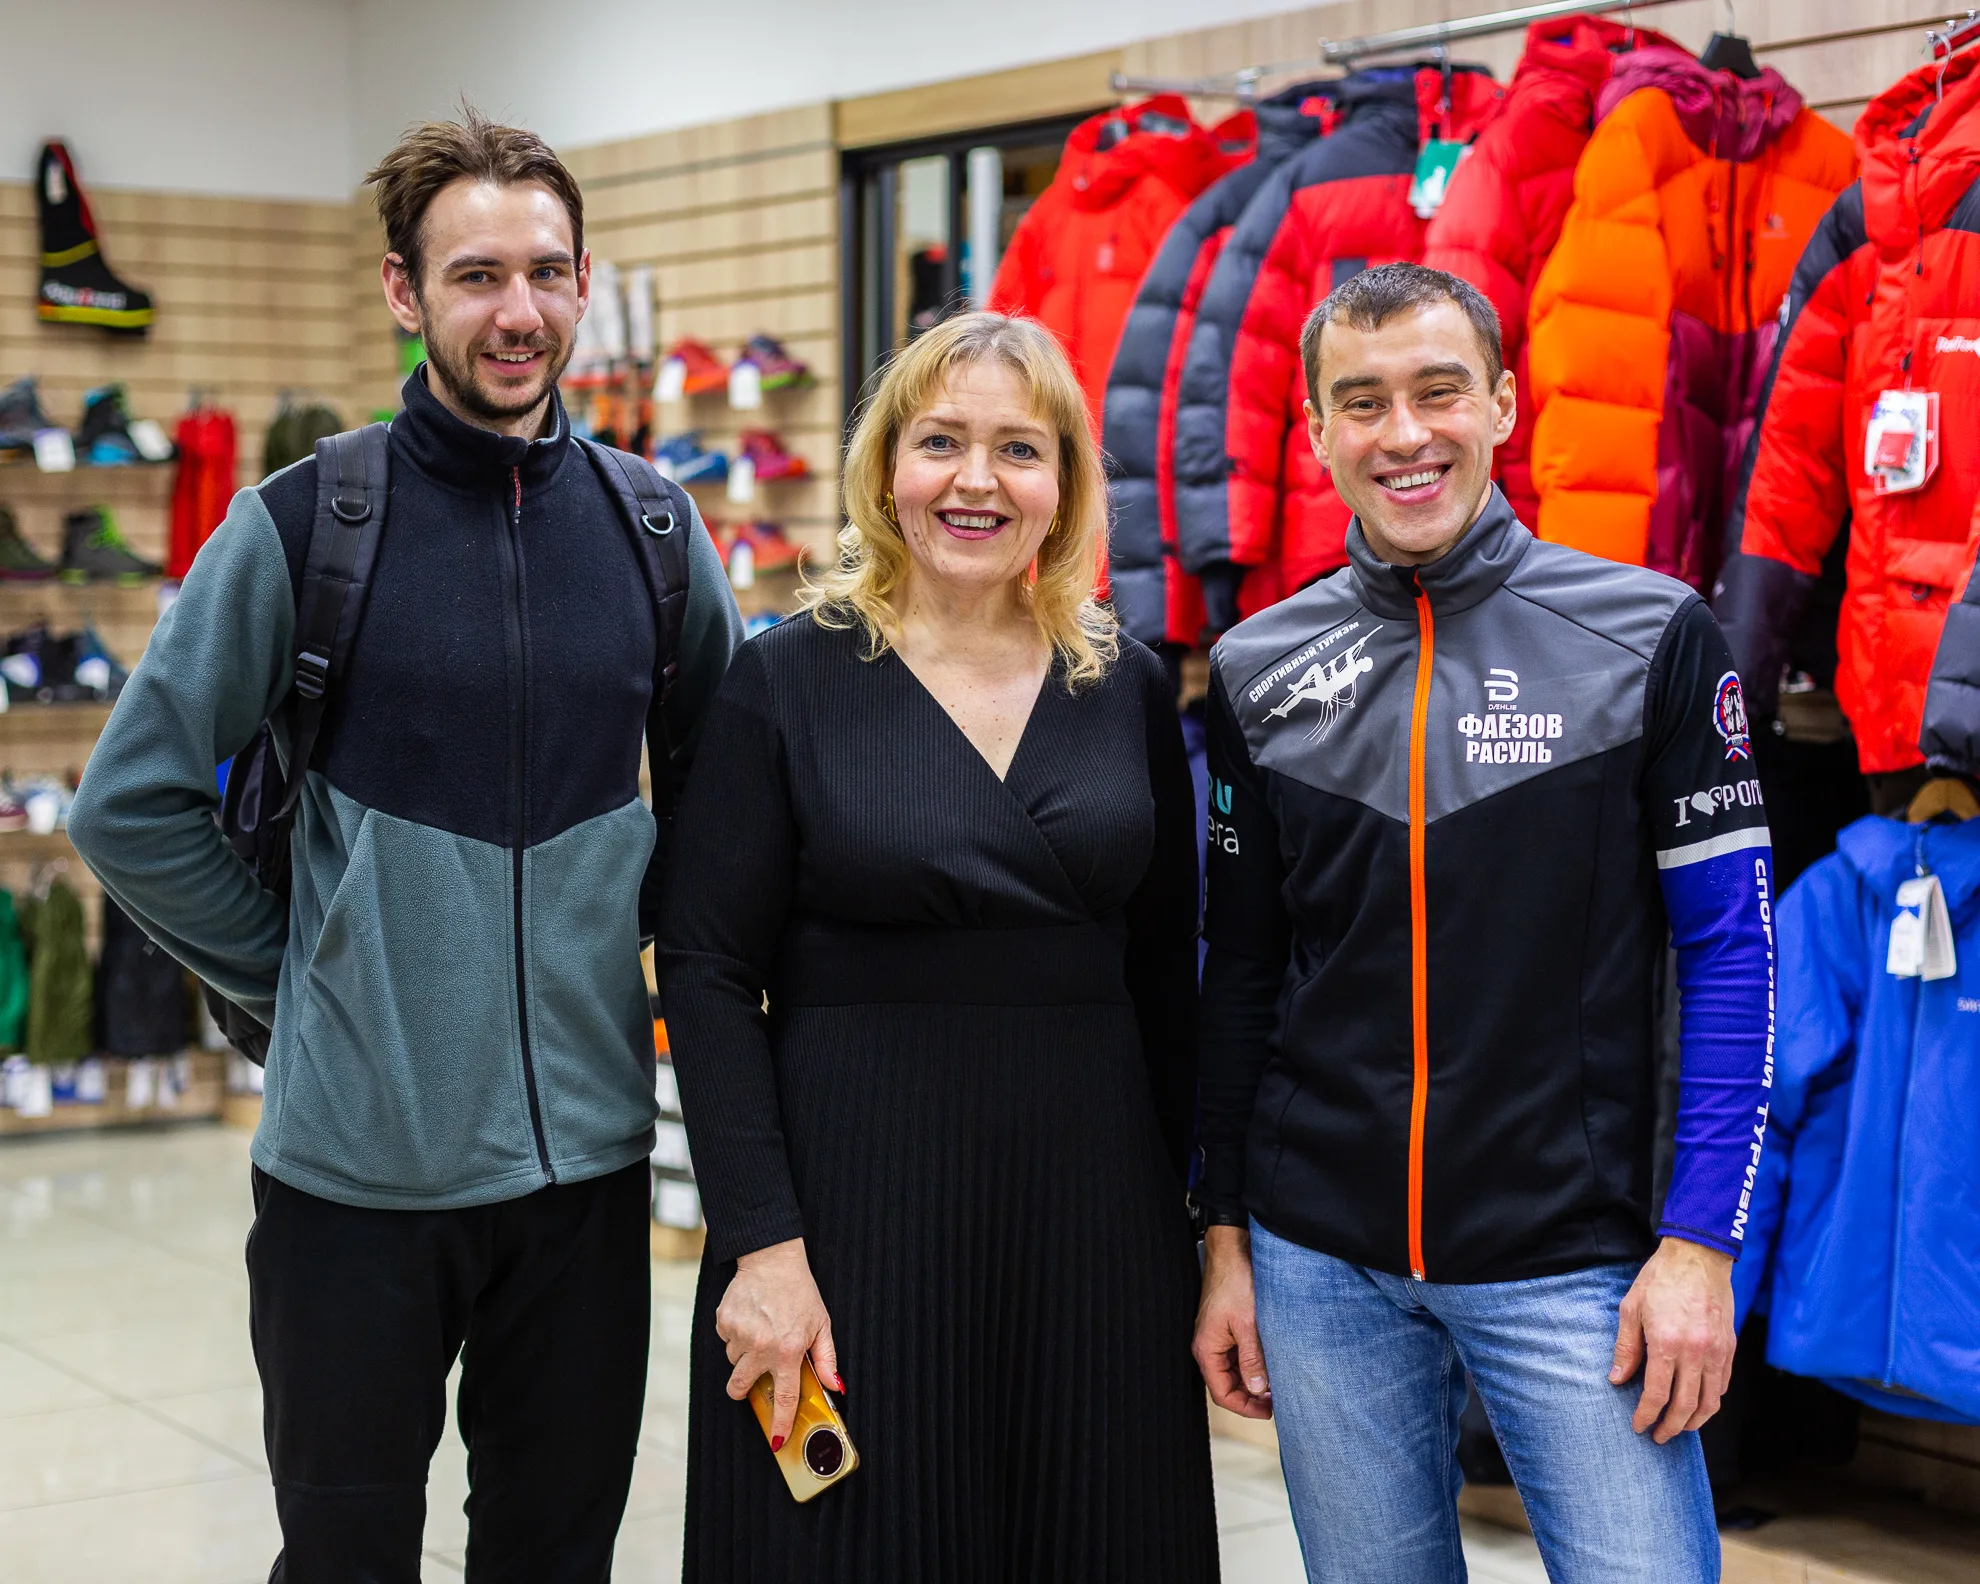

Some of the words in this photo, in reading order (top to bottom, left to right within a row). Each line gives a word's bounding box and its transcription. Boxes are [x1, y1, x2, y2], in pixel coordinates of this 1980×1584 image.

[1248, 645, 1320, 703] СПОРТИВНЫЙ
[1316, 621, 1360, 652] ТУРИЗМ
[1457, 712, 1563, 740] ФАЕЗОВ
[1466, 740, 1552, 764] РАСУЛЬ
[1730, 1101, 1770, 1241] ТУРИЗМ
